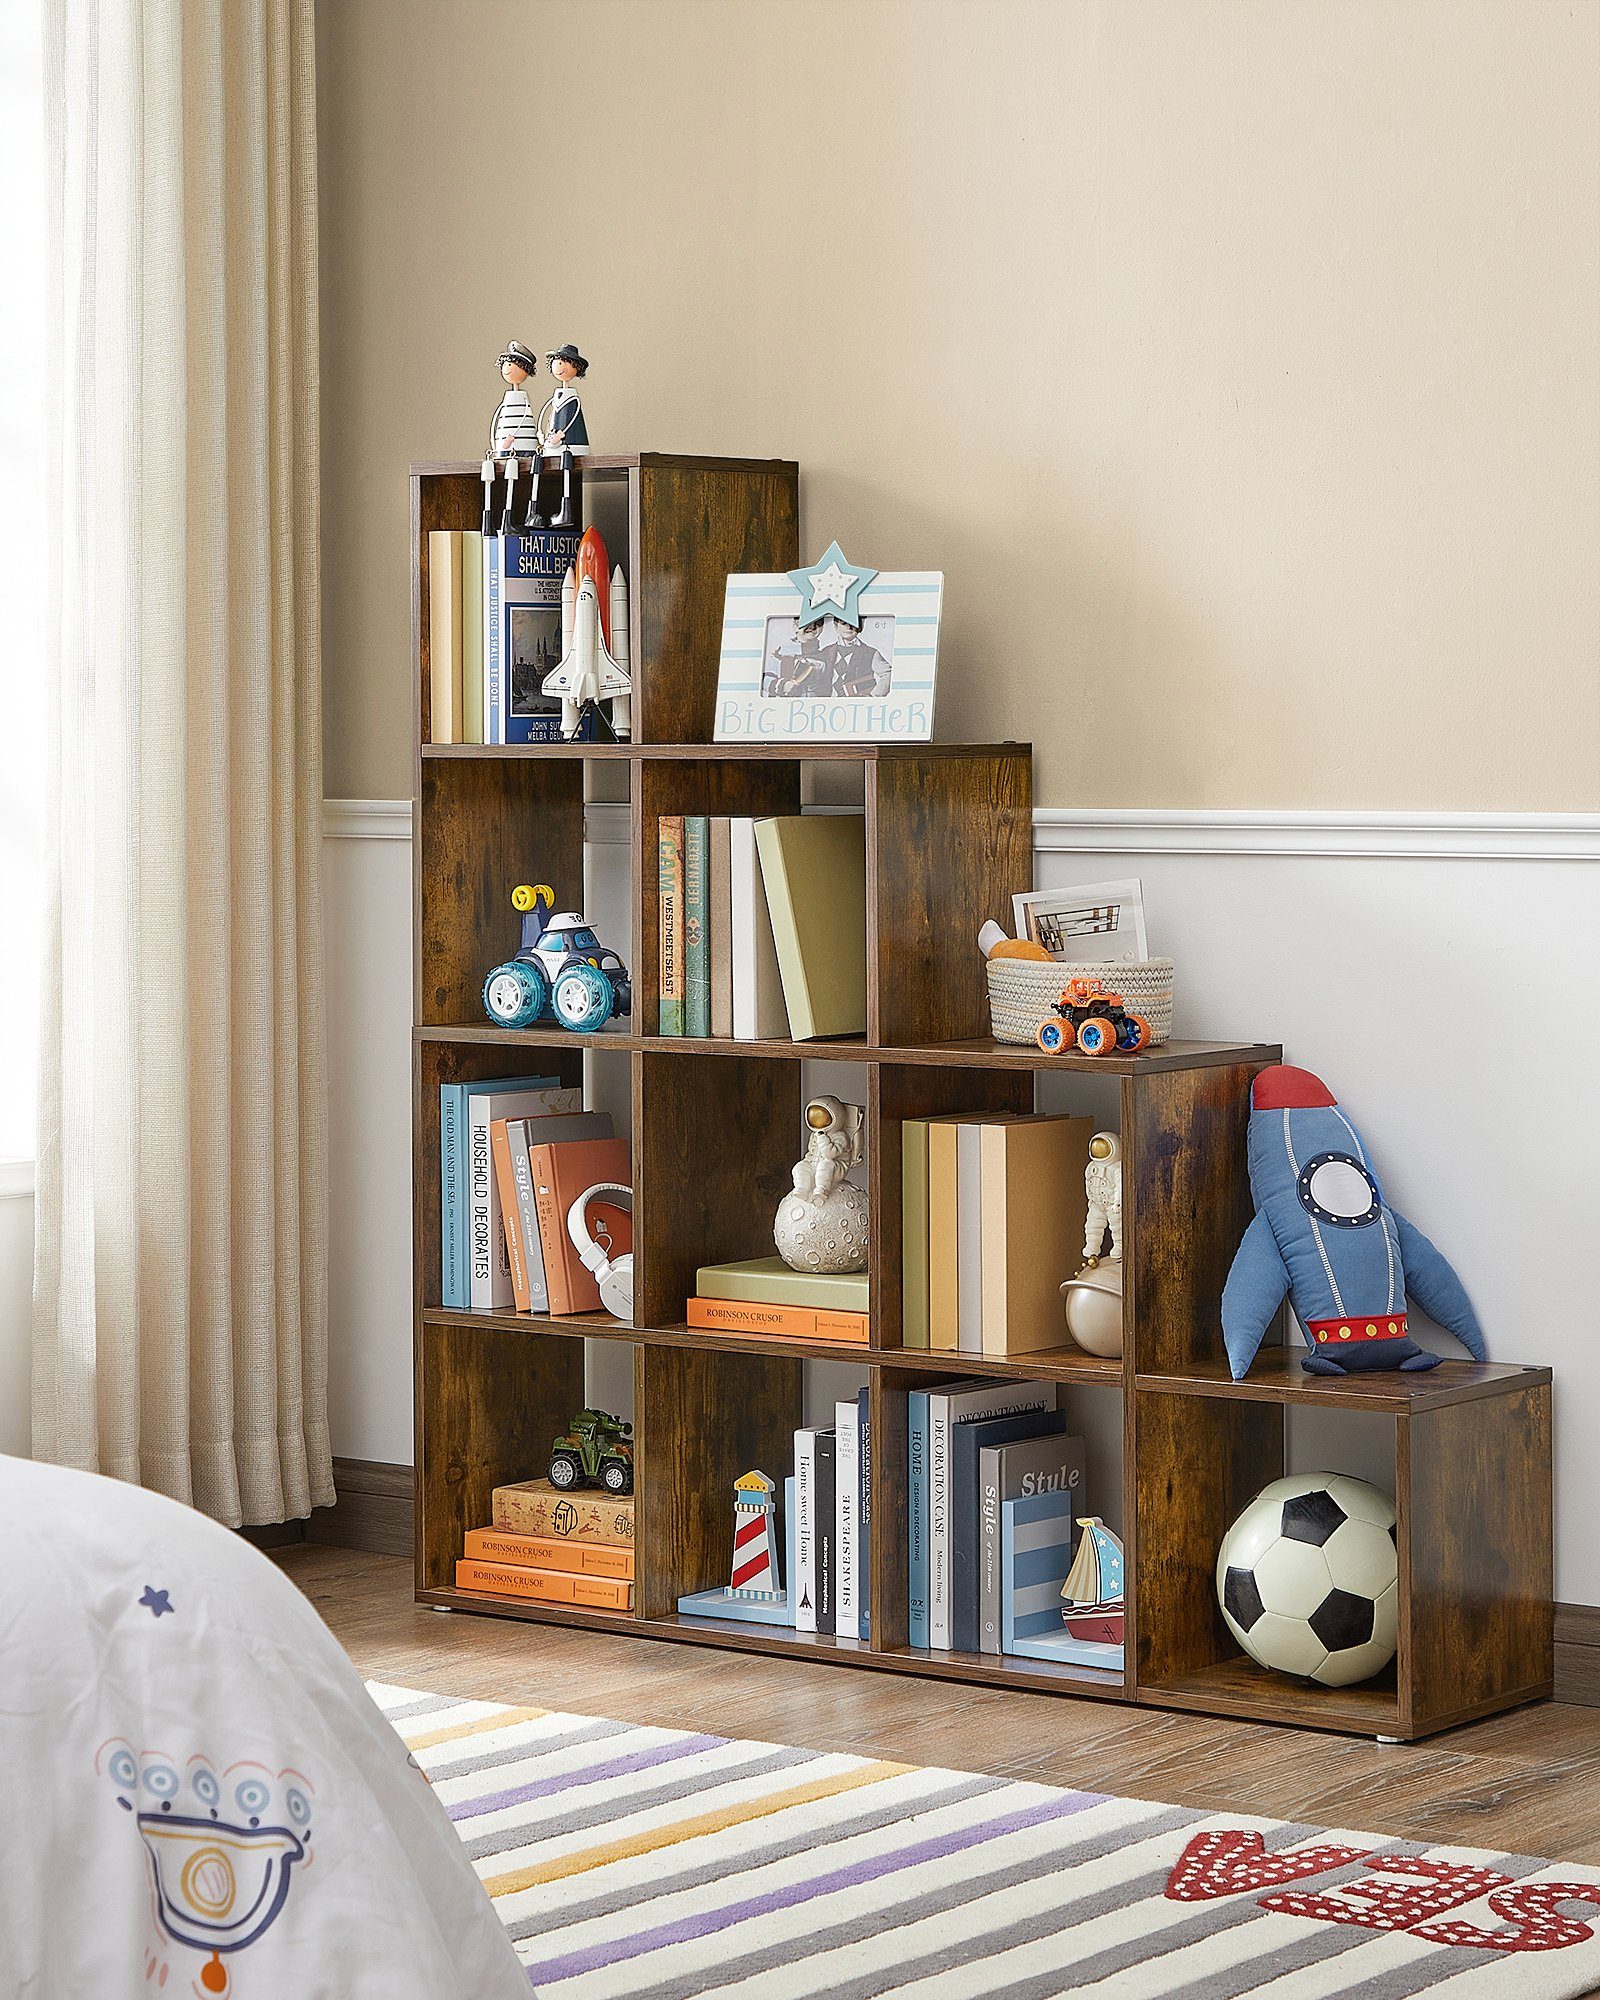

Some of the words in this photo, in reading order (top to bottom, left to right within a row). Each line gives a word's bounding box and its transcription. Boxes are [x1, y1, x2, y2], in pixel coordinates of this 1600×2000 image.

[518, 536, 545, 553] THAT
[546, 537, 581, 554] JUSTIC
[518, 555, 553, 574] SHALL
[554, 557, 568, 574] BE
[489, 568, 499, 590] THAT
[489, 595, 499, 631] JUSTICE
[489, 635, 499, 663] SHALL
[489, 668, 499, 679] BE
[489, 682, 499, 707] DONE
[527, 731, 547, 741] MELBA
[531, 721, 548, 731] JOHN
[549, 721, 561, 731] SUT
[665, 896, 674, 995] WESTMEETSEAST
[446, 1100, 454, 1116] THE
[446, 1117, 454, 1134] OLD
[447, 1154, 455, 1173] AND
[473, 1125, 488, 1198] HOUSEHOLD
[447, 1174, 455, 1190] THE
[515, 1155, 530, 1201] Style
[447, 1190, 455, 1205] SEA
[474, 1206, 489, 1279] DECORATES
[508, 1216, 517, 1247] Concepts
[512, 1249, 523, 1291] Metaphorical
[706, 1308, 750, 1321] ROBINSON
[750, 1312, 784, 1324] CRUSOE
[912, 1430, 922, 1475] HOME
[934, 1419, 944, 1503] DECORATION
[800, 1455, 810, 1492] Home
[1020, 1464, 1080, 1499] Style
[800, 1495, 808, 1526] sweet
[934, 1505, 944, 1537] CASE
[982, 1485, 996, 1535] Style
[481, 1541, 522, 1555] ROBINSON
[522, 1546, 553, 1558] CRUSOE
[800, 1529, 810, 1567] Home
[842, 1494, 850, 1607] SHAKESPEARE
[473, 1571, 513, 1583] ROBINSON
[513, 1576, 544, 1588] CRUSOE
[935, 1581, 943, 1604] living
